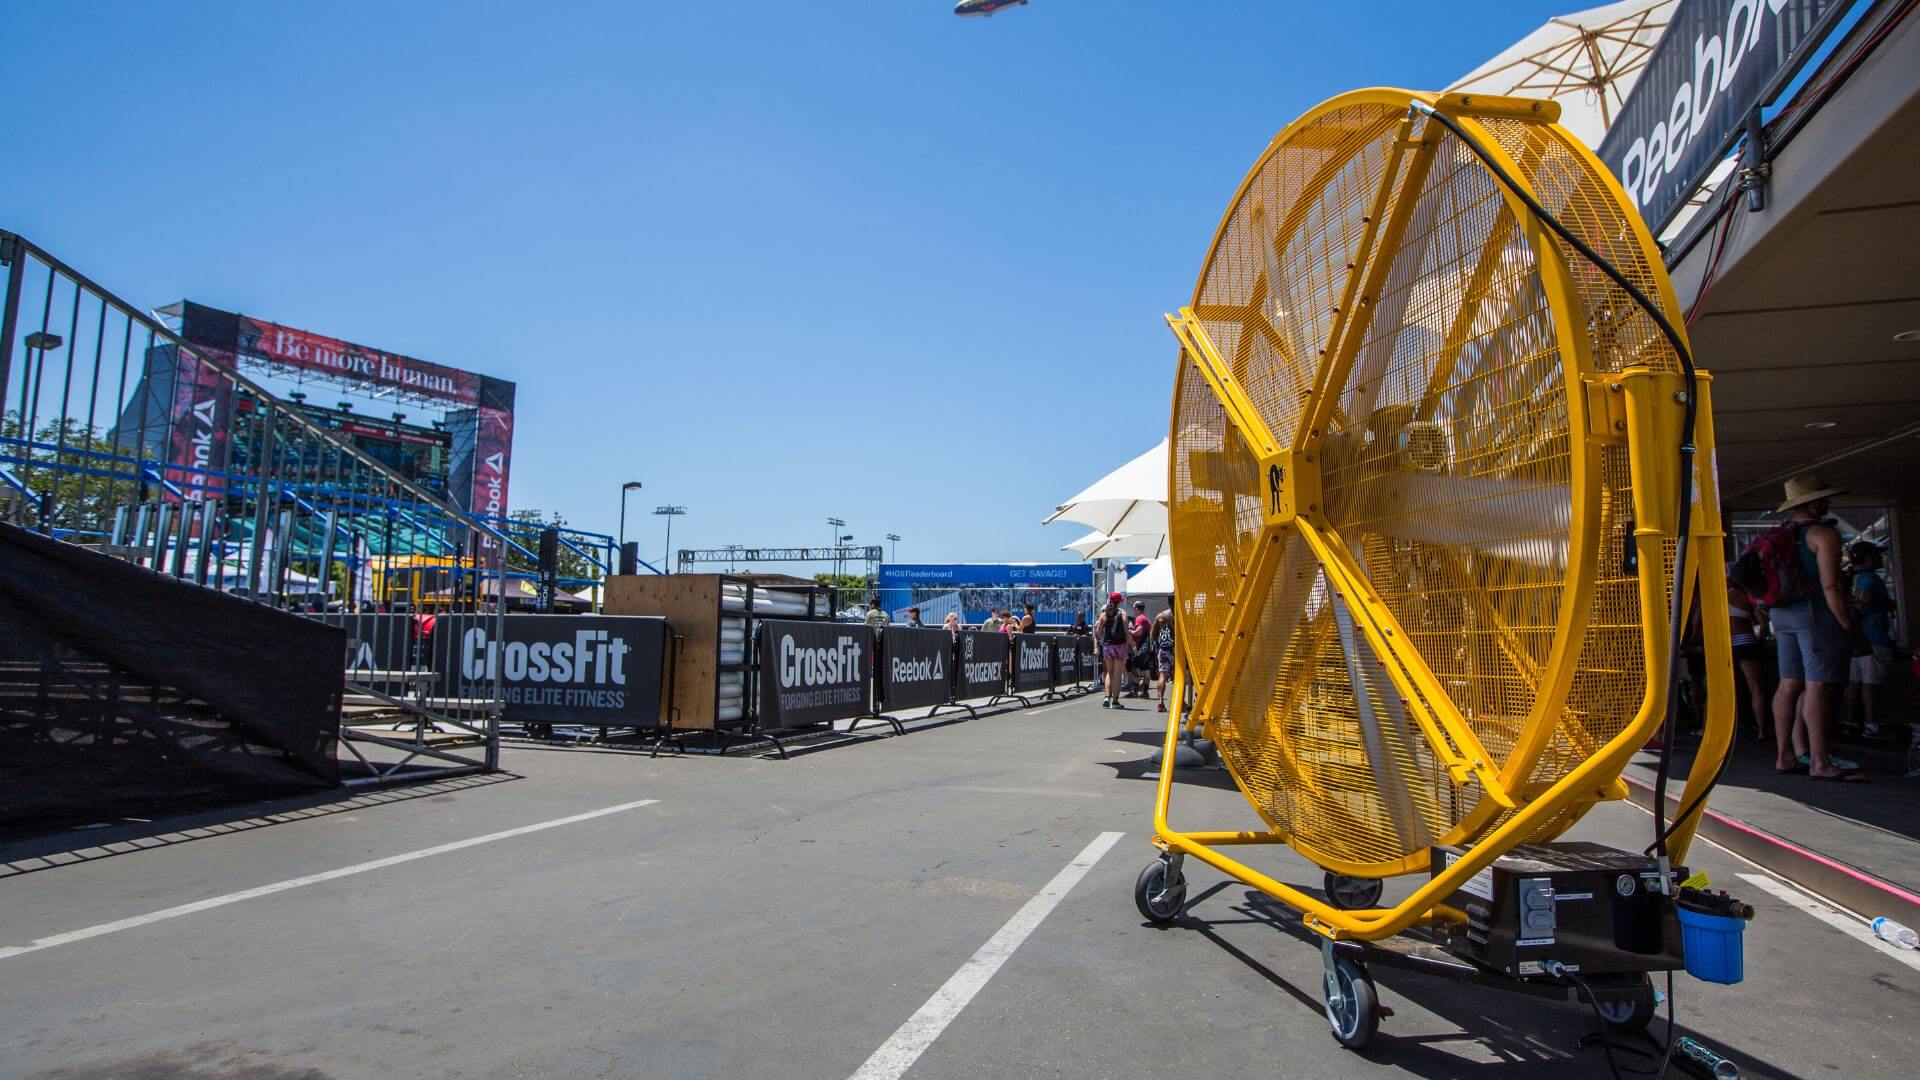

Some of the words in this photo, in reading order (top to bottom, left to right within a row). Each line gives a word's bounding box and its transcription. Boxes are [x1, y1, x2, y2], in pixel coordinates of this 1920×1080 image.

[275, 329, 310, 361] Be
[315, 351, 375, 376] more
[380, 355, 458, 395] human.
[1010, 569, 1026, 578] GET
[1030, 569, 1067, 578] SAVAGE!
[462, 627, 628, 685] CrossFit
[780, 634, 861, 688] CrossFit
[1020, 640, 1049, 670] CrossFit
[892, 656, 932, 683] Reebok
[964, 661, 1002, 684] PROGENEX
[459, 684, 521, 704] FORGNG
[524, 687, 563, 706] ELITE
[565, 689, 625, 709] FITNESS
[780, 690, 815, 711] FORGING
[814, 689, 833, 707] ELITE
[833, 686, 861, 704] FITNESS
